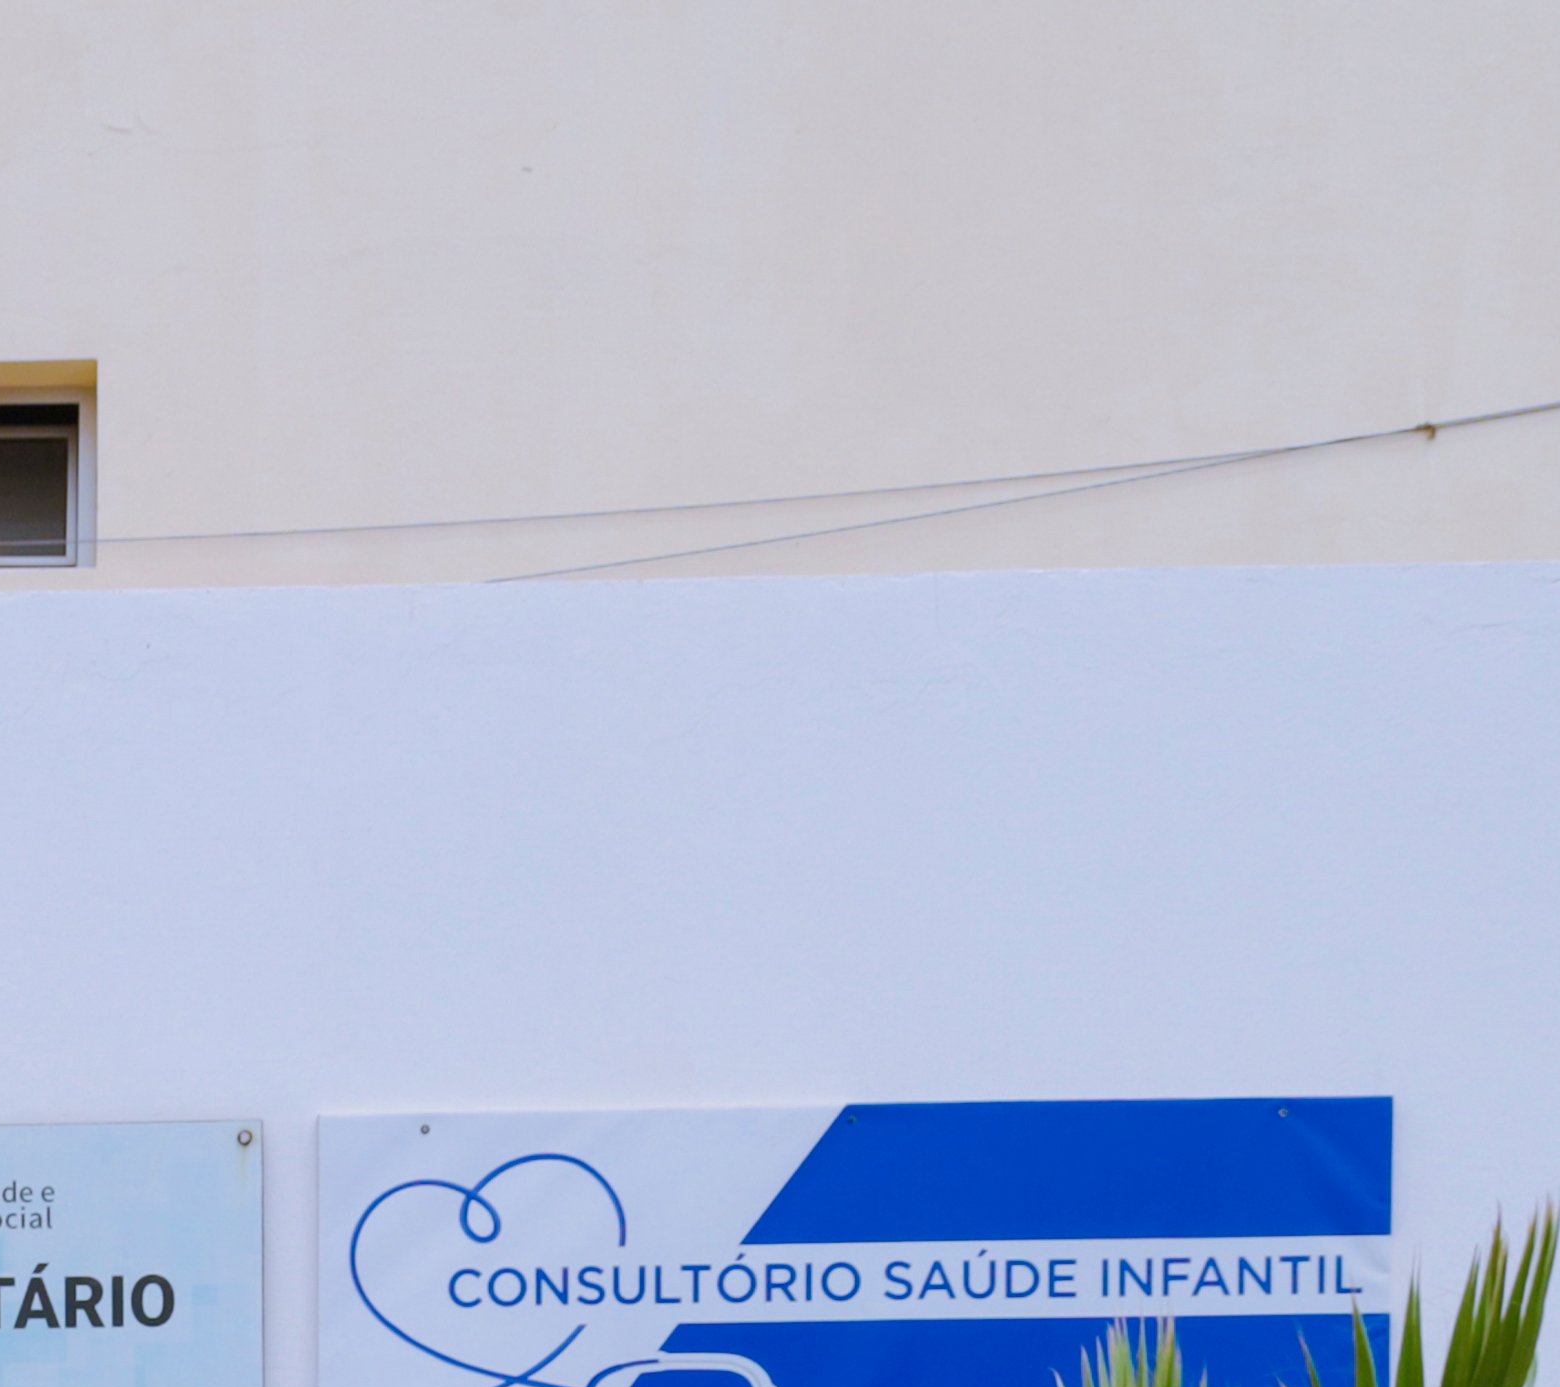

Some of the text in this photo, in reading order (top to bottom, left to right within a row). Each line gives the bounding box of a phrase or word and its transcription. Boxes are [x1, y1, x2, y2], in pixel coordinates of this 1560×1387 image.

[41, 1186, 55, 1203] e
[448, 1249, 1363, 1308] CONSULTÓRIO SAÚDE INFANTIL
